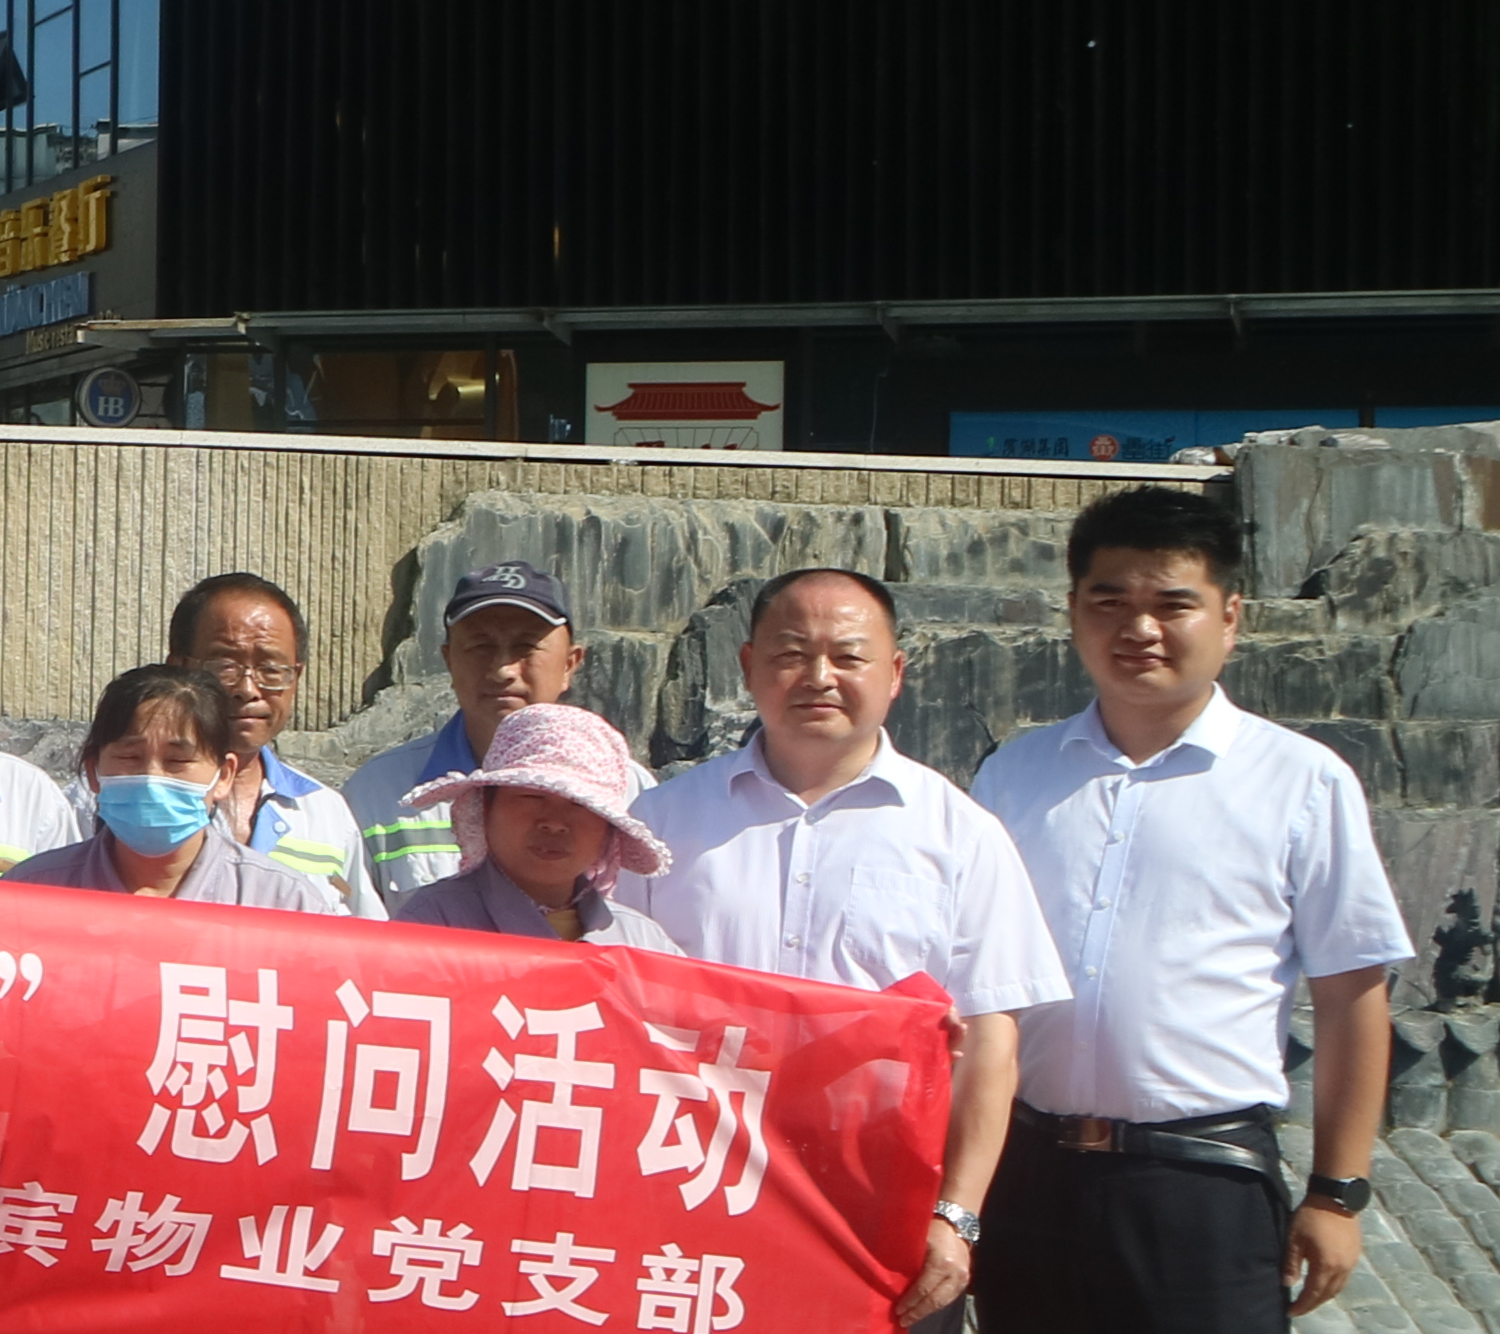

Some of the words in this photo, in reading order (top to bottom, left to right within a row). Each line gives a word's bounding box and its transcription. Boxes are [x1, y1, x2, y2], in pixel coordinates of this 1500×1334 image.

[96, 395, 126, 418] HB
[138, 960, 773, 1218] 慰问活动
